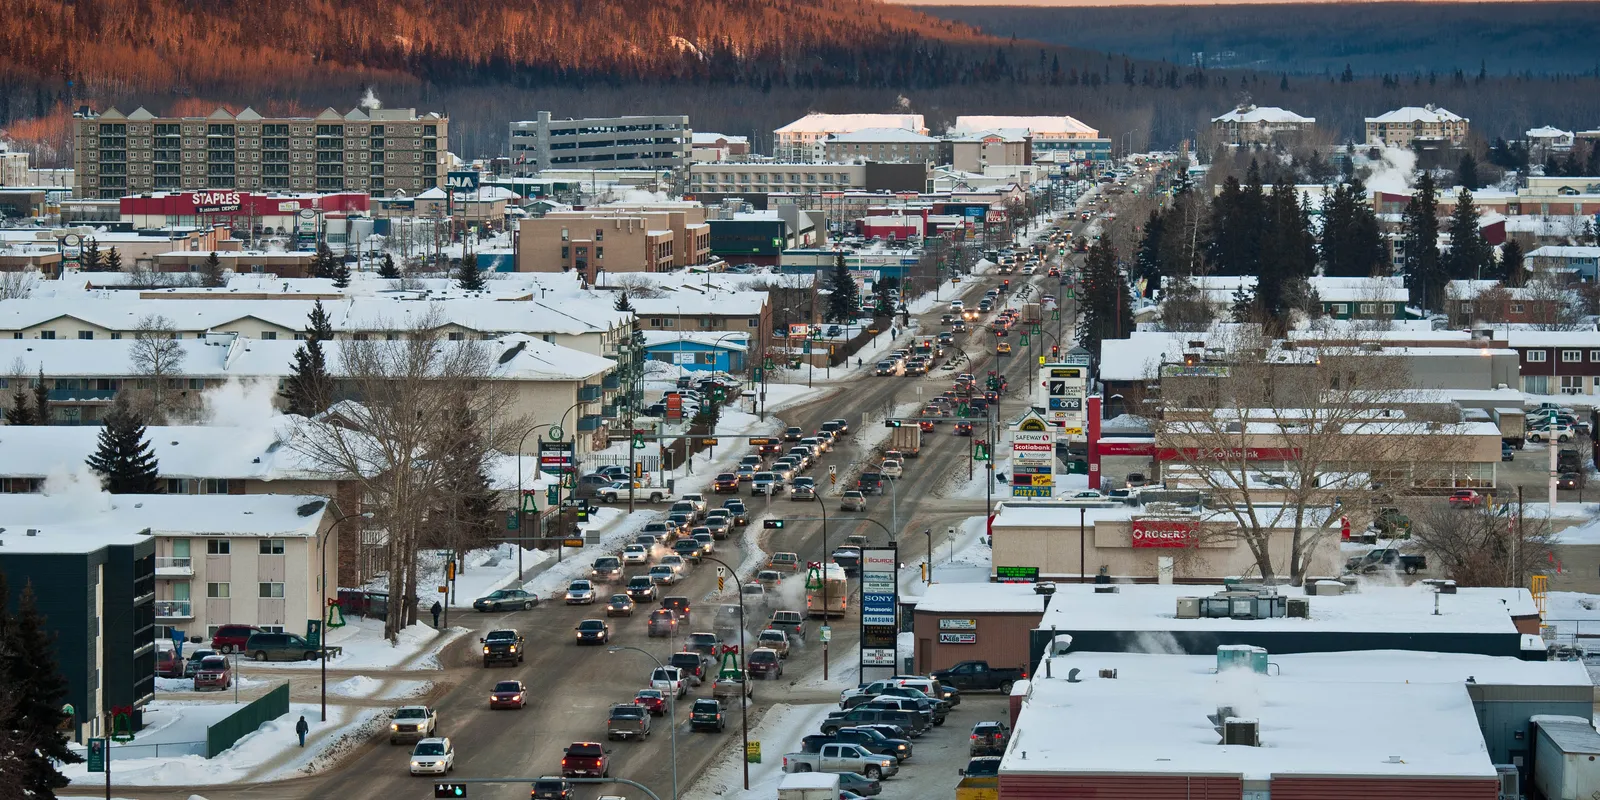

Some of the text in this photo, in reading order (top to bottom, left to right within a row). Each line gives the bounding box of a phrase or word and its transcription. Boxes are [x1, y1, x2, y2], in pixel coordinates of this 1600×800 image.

[192, 192, 240, 205] STAPLES
[1014, 489, 1050, 497] PIZZA 73
[1144, 530, 1187, 539] ROGERS
